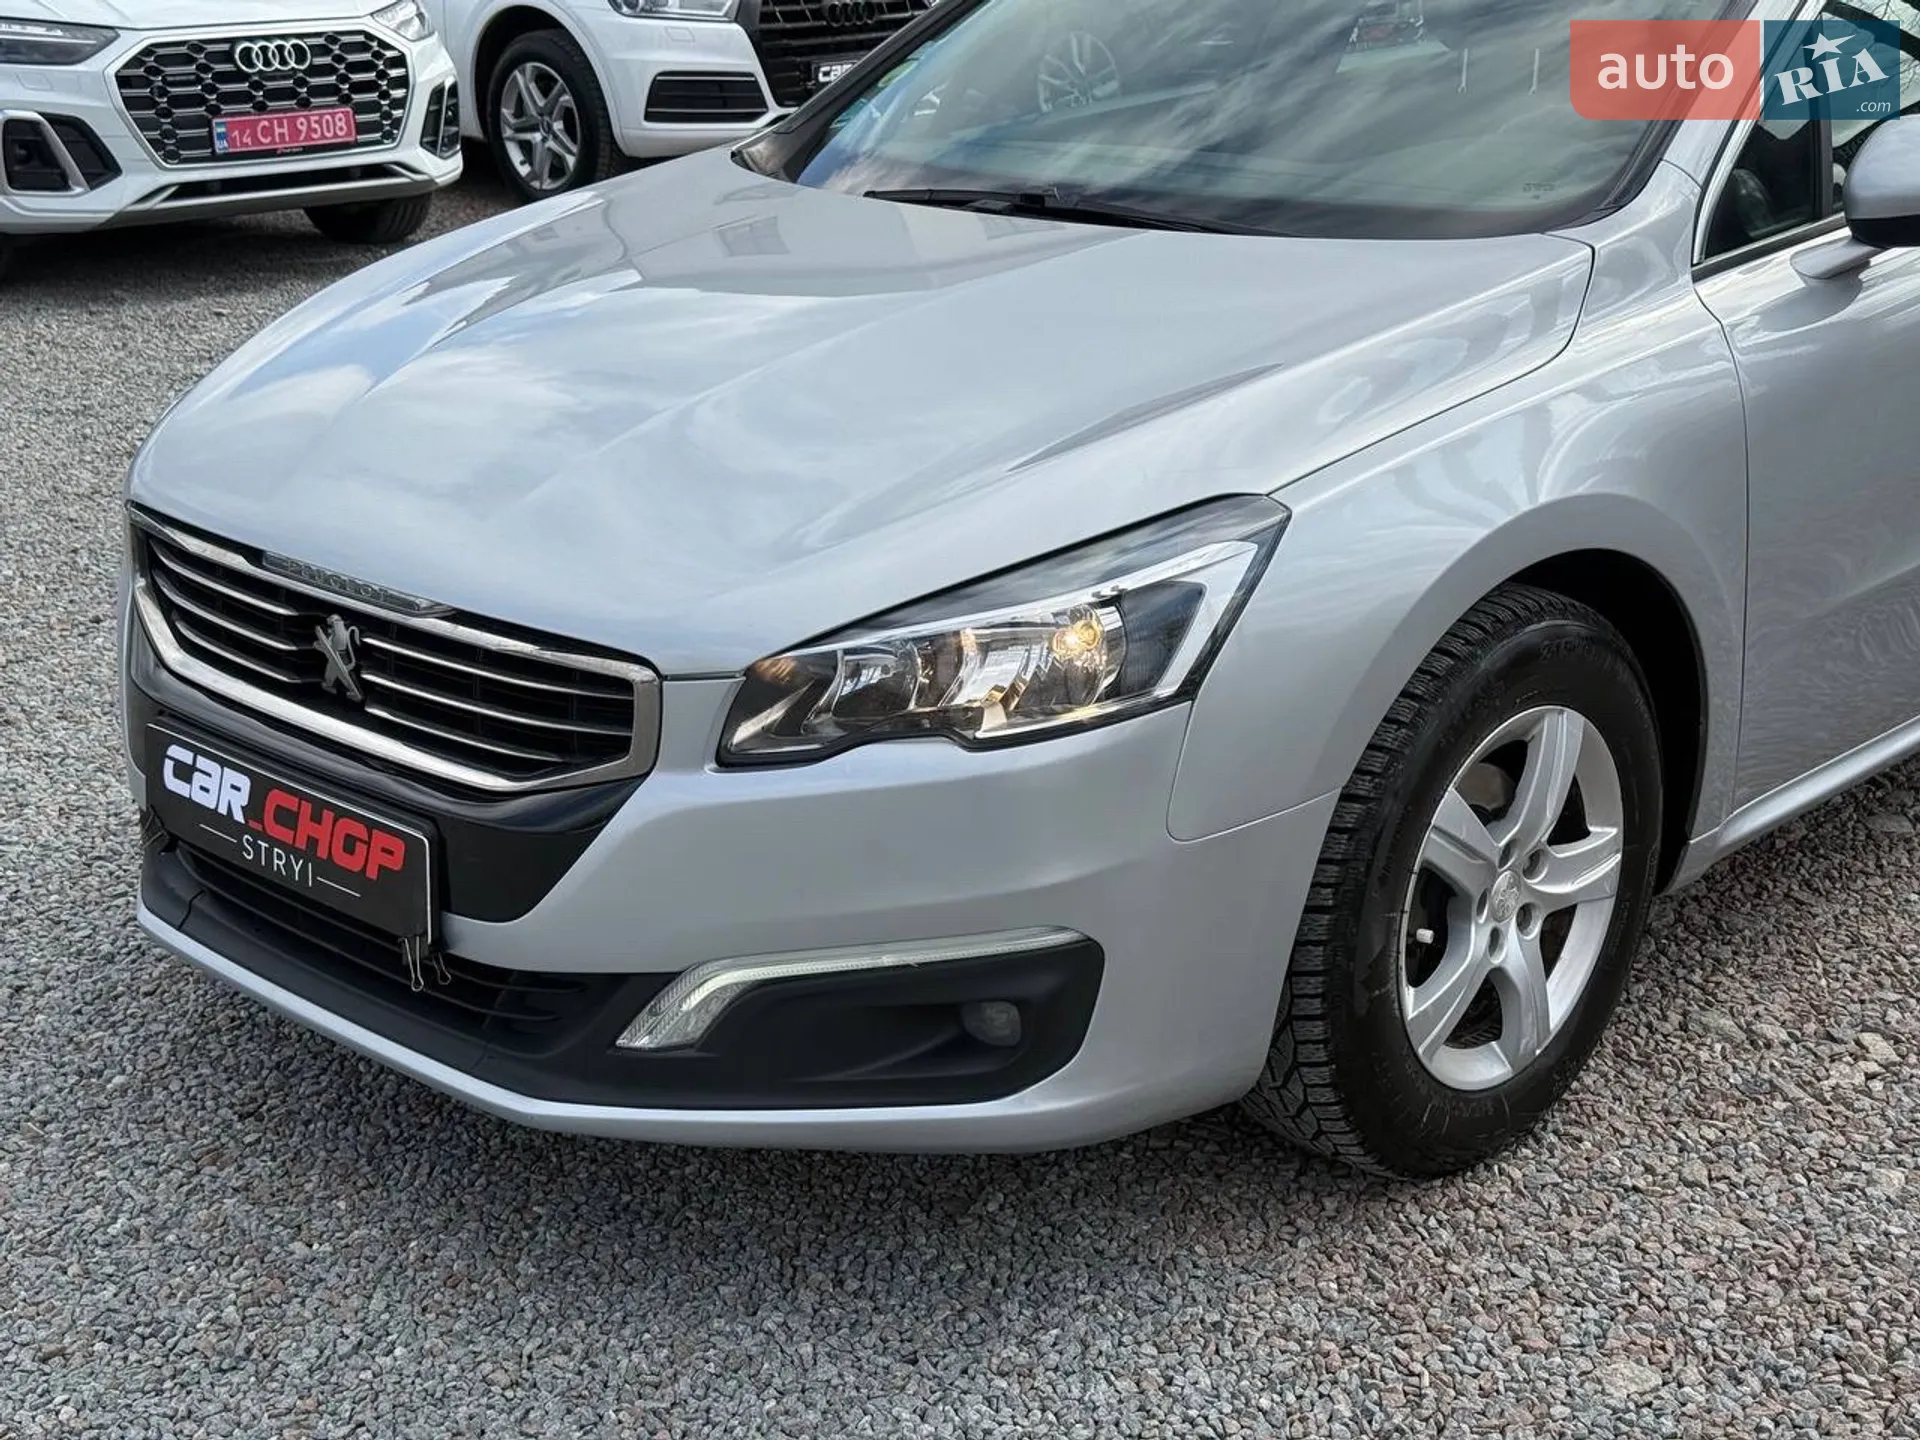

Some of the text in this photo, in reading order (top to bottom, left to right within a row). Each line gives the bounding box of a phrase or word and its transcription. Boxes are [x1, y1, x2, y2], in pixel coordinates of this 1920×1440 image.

[231, 112, 348, 147] 14 CH 9508
[242, 834, 313, 887] STRYI
